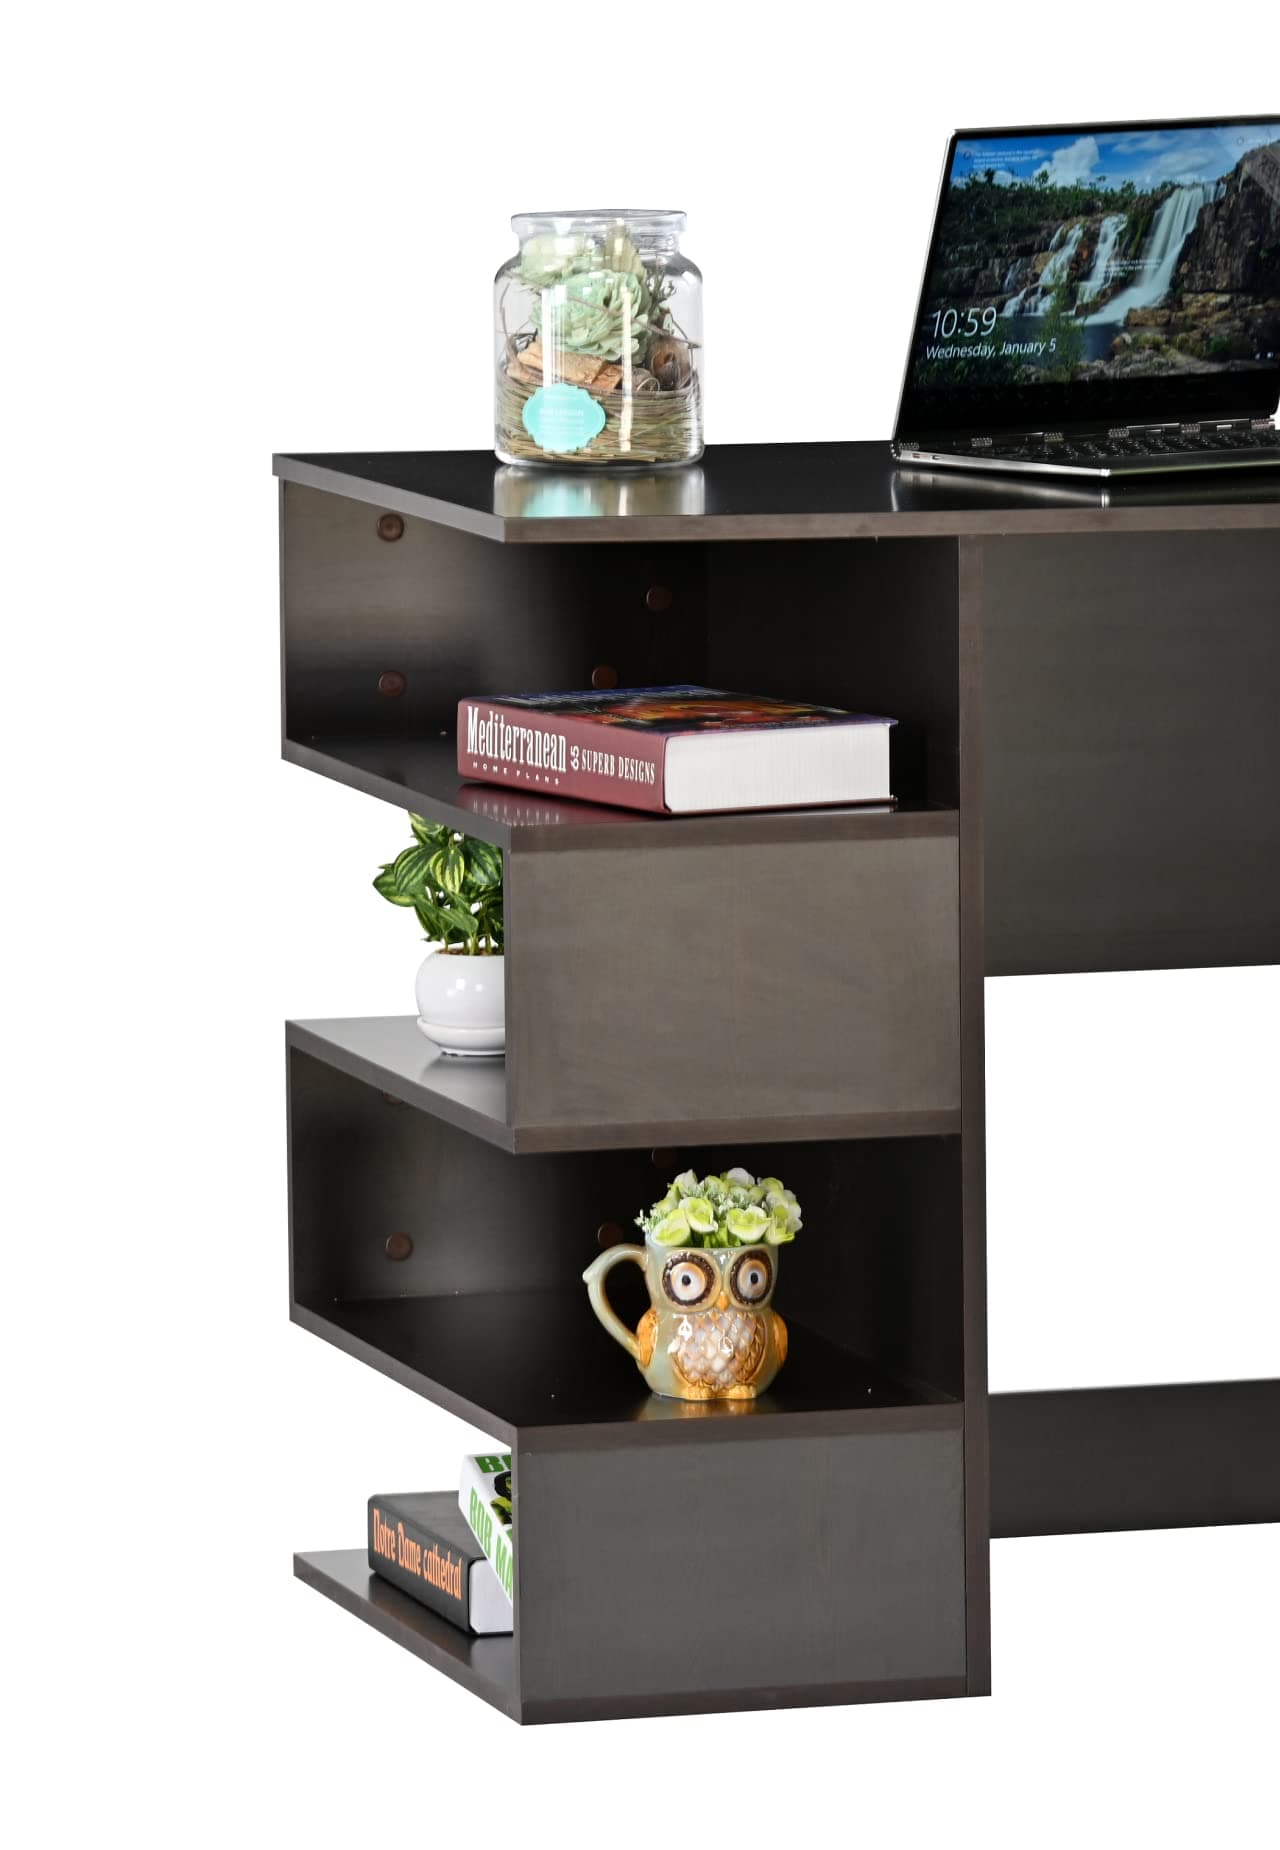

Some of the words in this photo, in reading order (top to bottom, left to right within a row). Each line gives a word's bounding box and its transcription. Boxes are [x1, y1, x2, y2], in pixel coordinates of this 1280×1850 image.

[932, 306, 997, 338] 10:59
[926, 342, 996, 360] Wednesday,
[1000, 341, 1046, 356] January
[1049, 338, 1057, 352] 5
[467, 705, 567, 773] Mediterranean
[581, 749, 615, 776] SUPERB
[618, 756, 655, 784] DESIGNS
[473, 762, 507, 775] HOME
[517, 769, 559, 785] PLANS
[373, 1508, 396, 1561] Notre
[398, 1521, 421, 1576] Dame
[423, 1543, 462, 1601] cathedral
